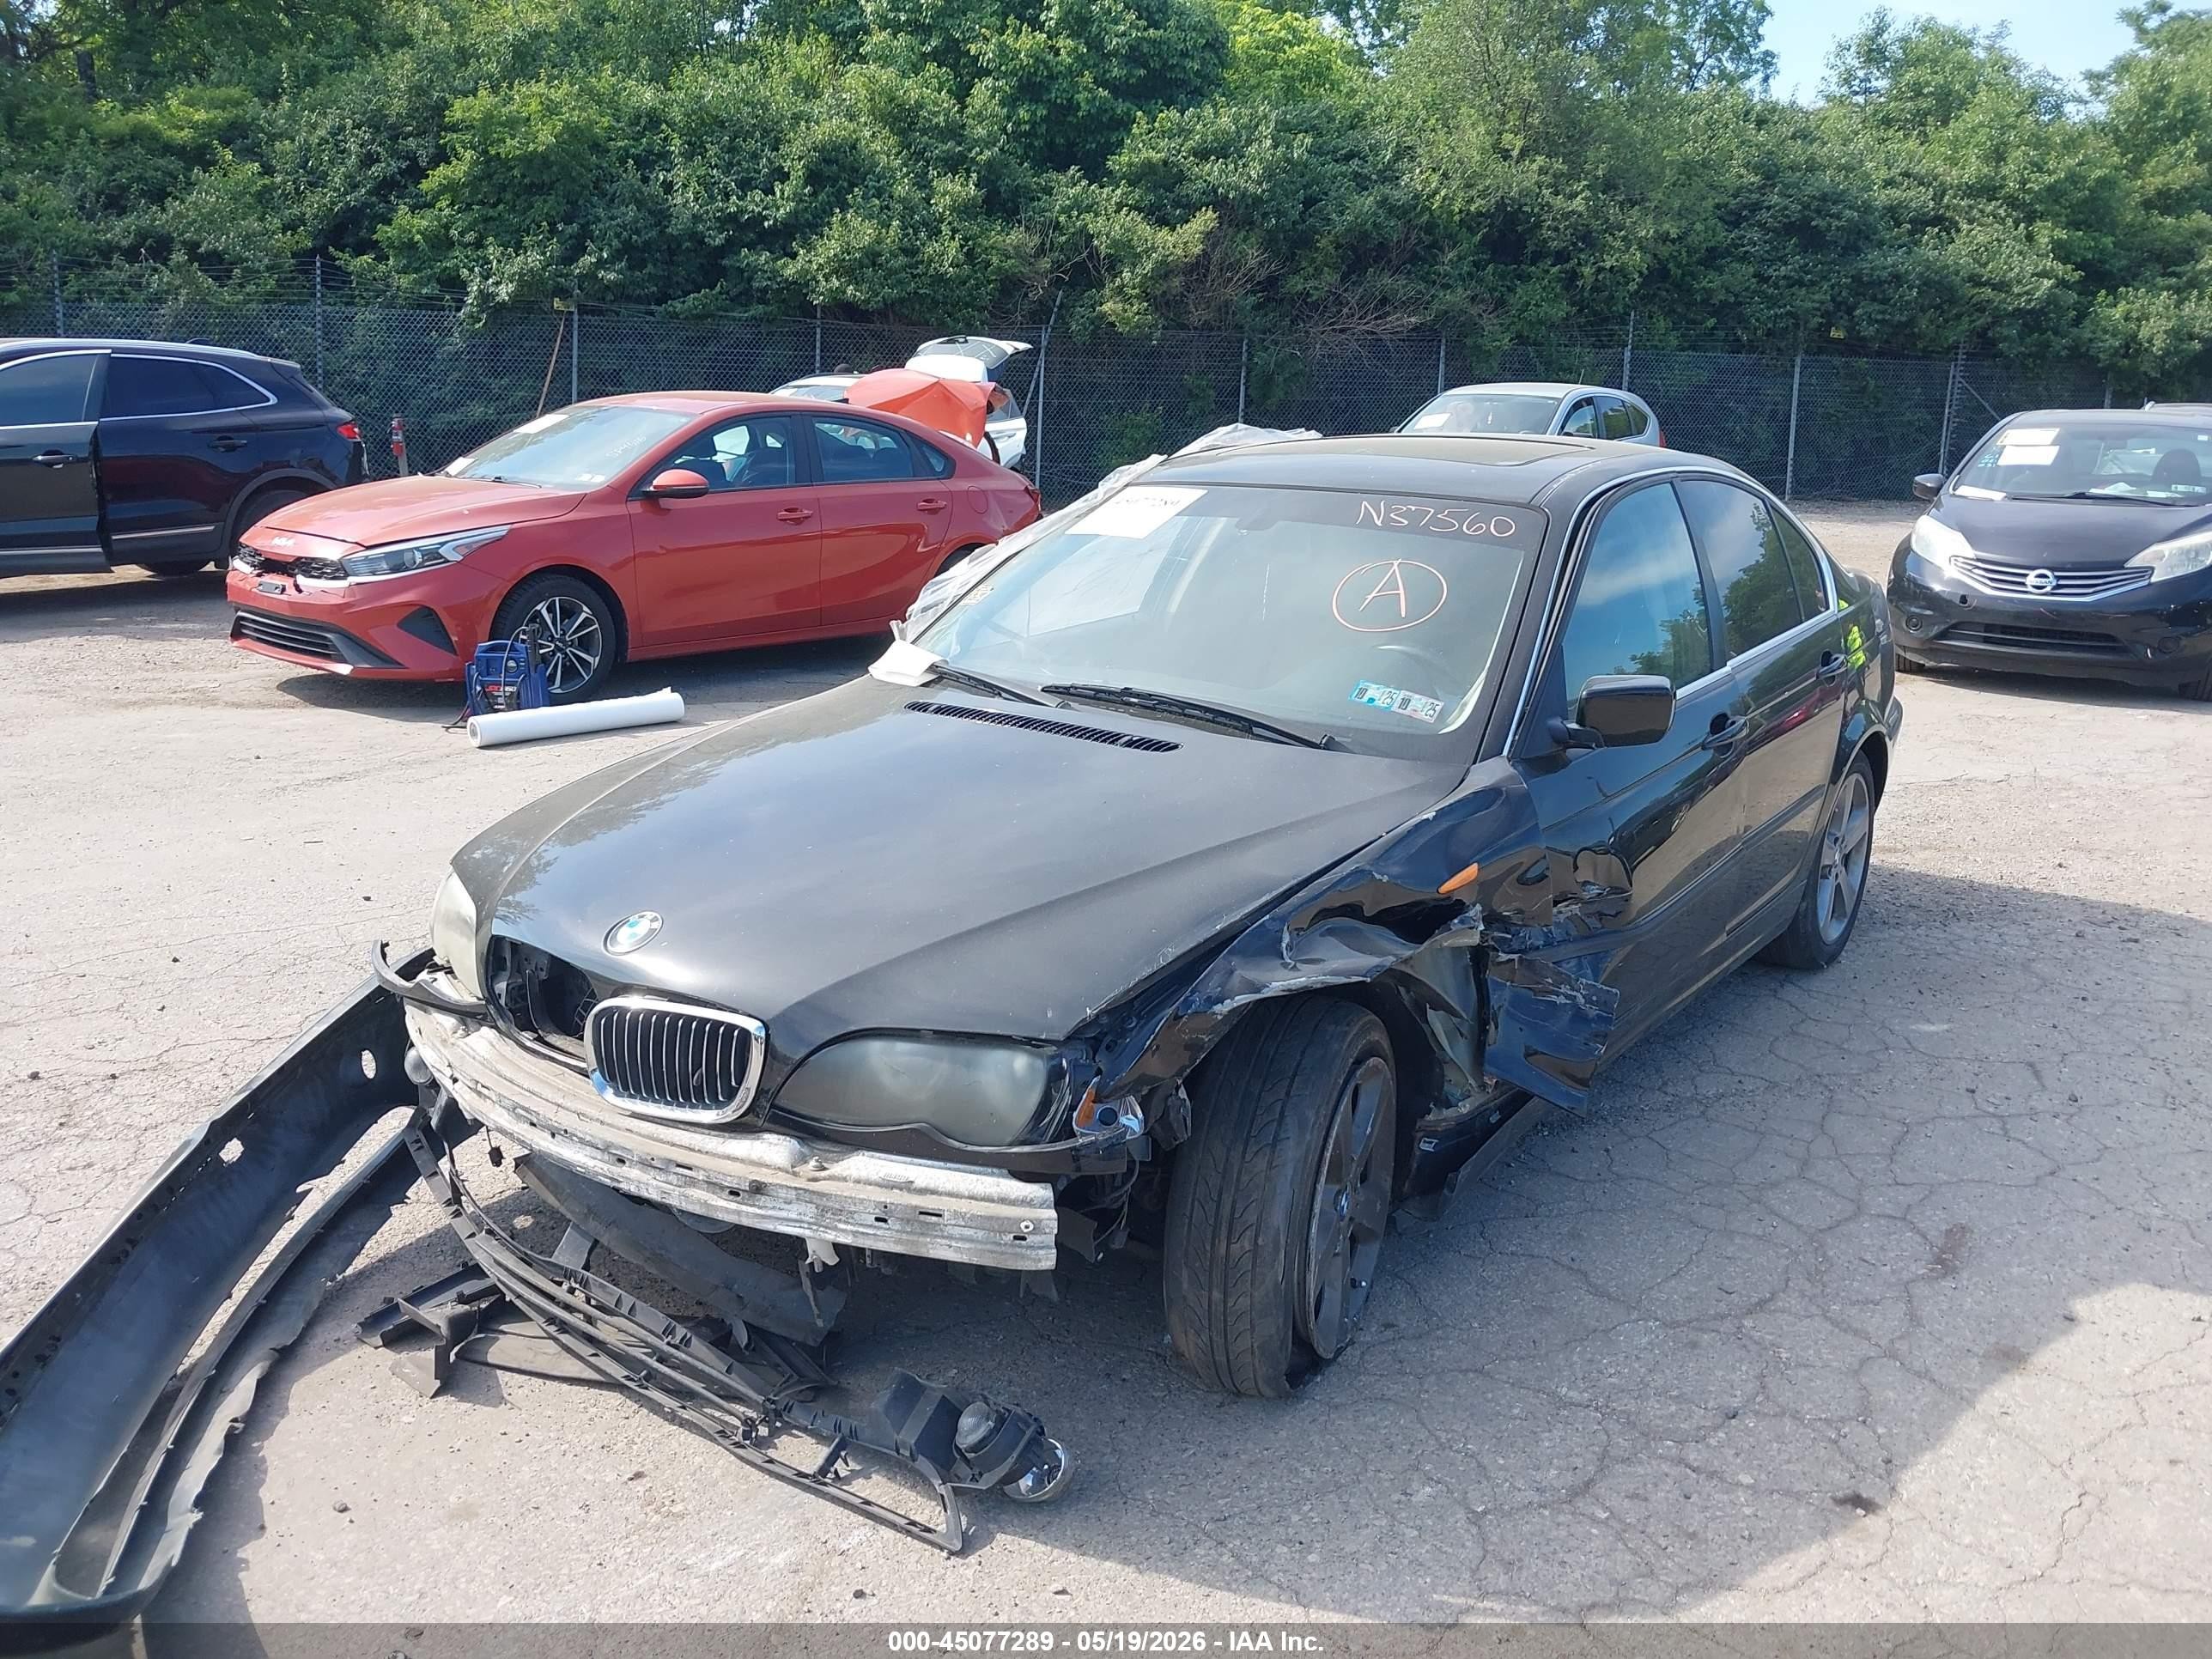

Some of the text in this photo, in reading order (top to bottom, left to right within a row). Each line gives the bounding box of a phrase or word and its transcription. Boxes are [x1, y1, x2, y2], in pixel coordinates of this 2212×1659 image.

[1356, 500, 1516, 537] N37560
[1358, 558, 1407, 618] A
[1354, 687, 1369, 700] 10
[1397, 696, 1412, 711] 10
